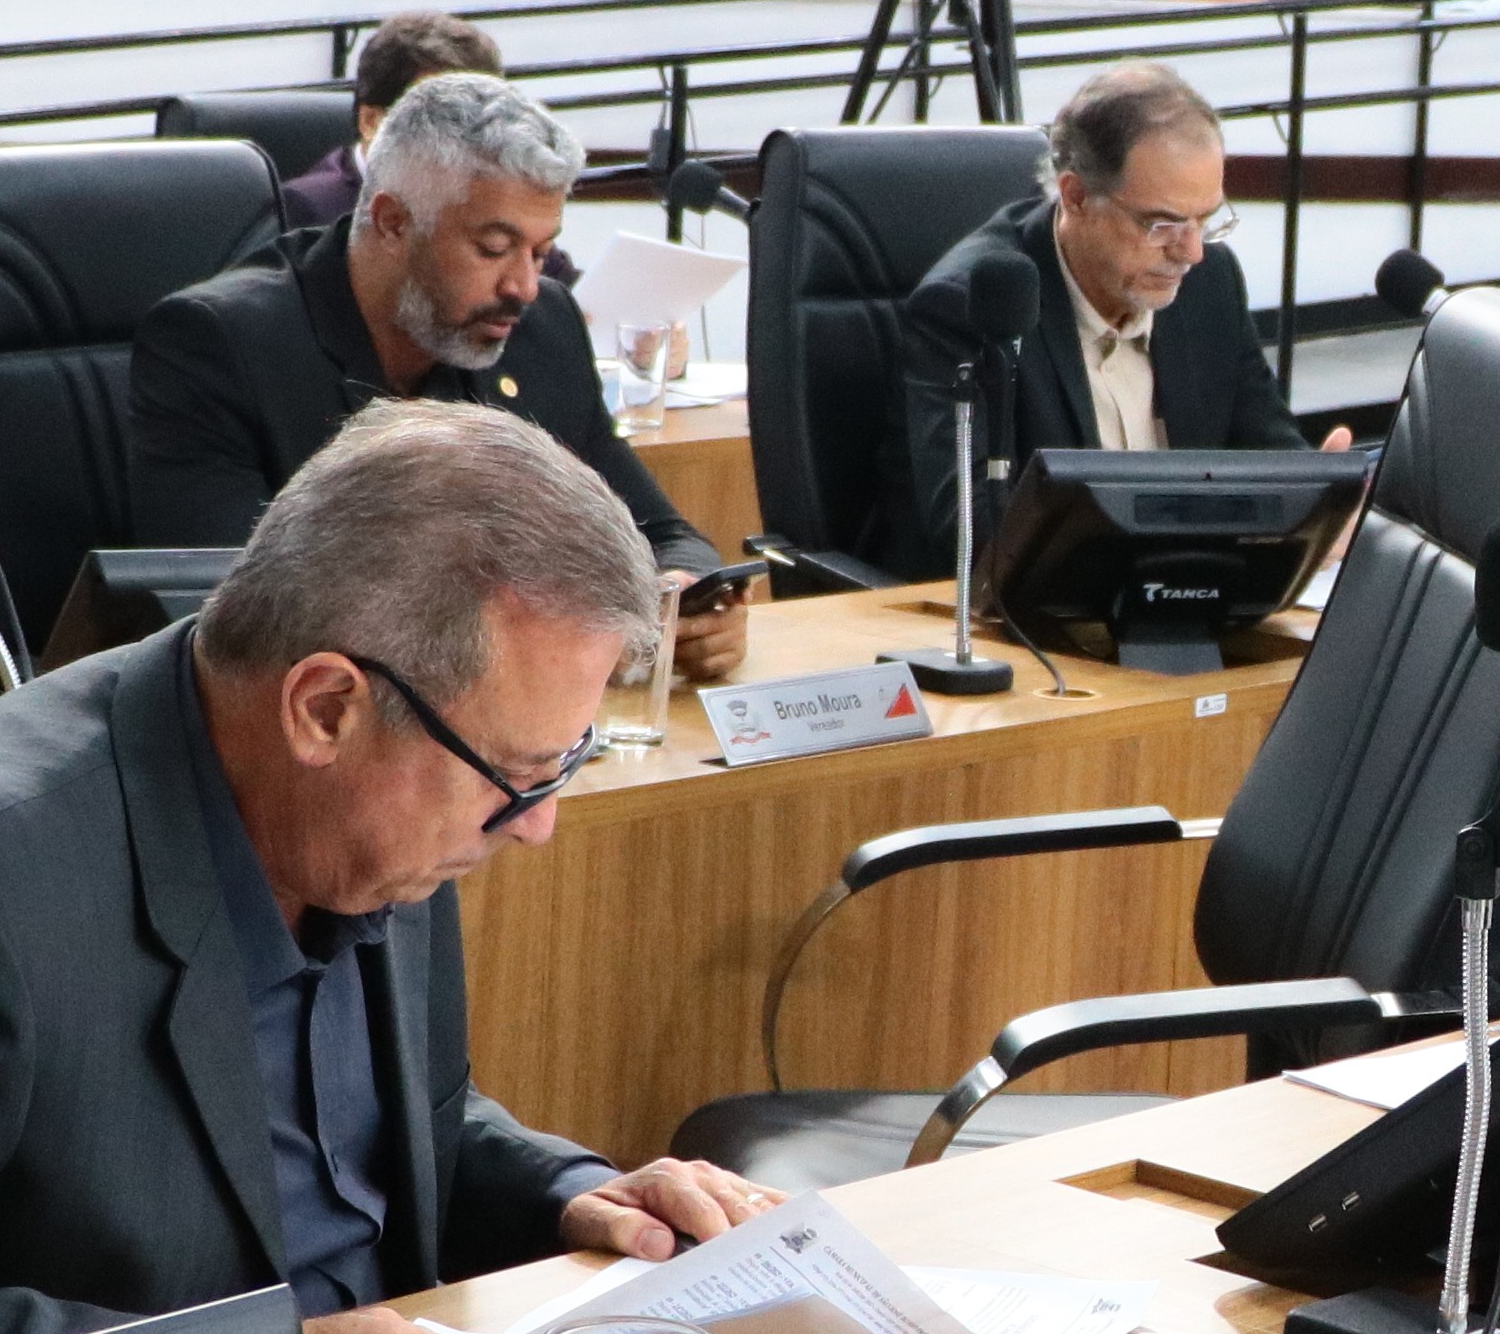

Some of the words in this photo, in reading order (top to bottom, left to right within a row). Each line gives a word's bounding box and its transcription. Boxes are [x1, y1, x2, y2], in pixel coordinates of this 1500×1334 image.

[1161, 588, 1220, 601] TANCA
[773, 700, 818, 720] Bruno
[817, 694, 862, 713] Moura
